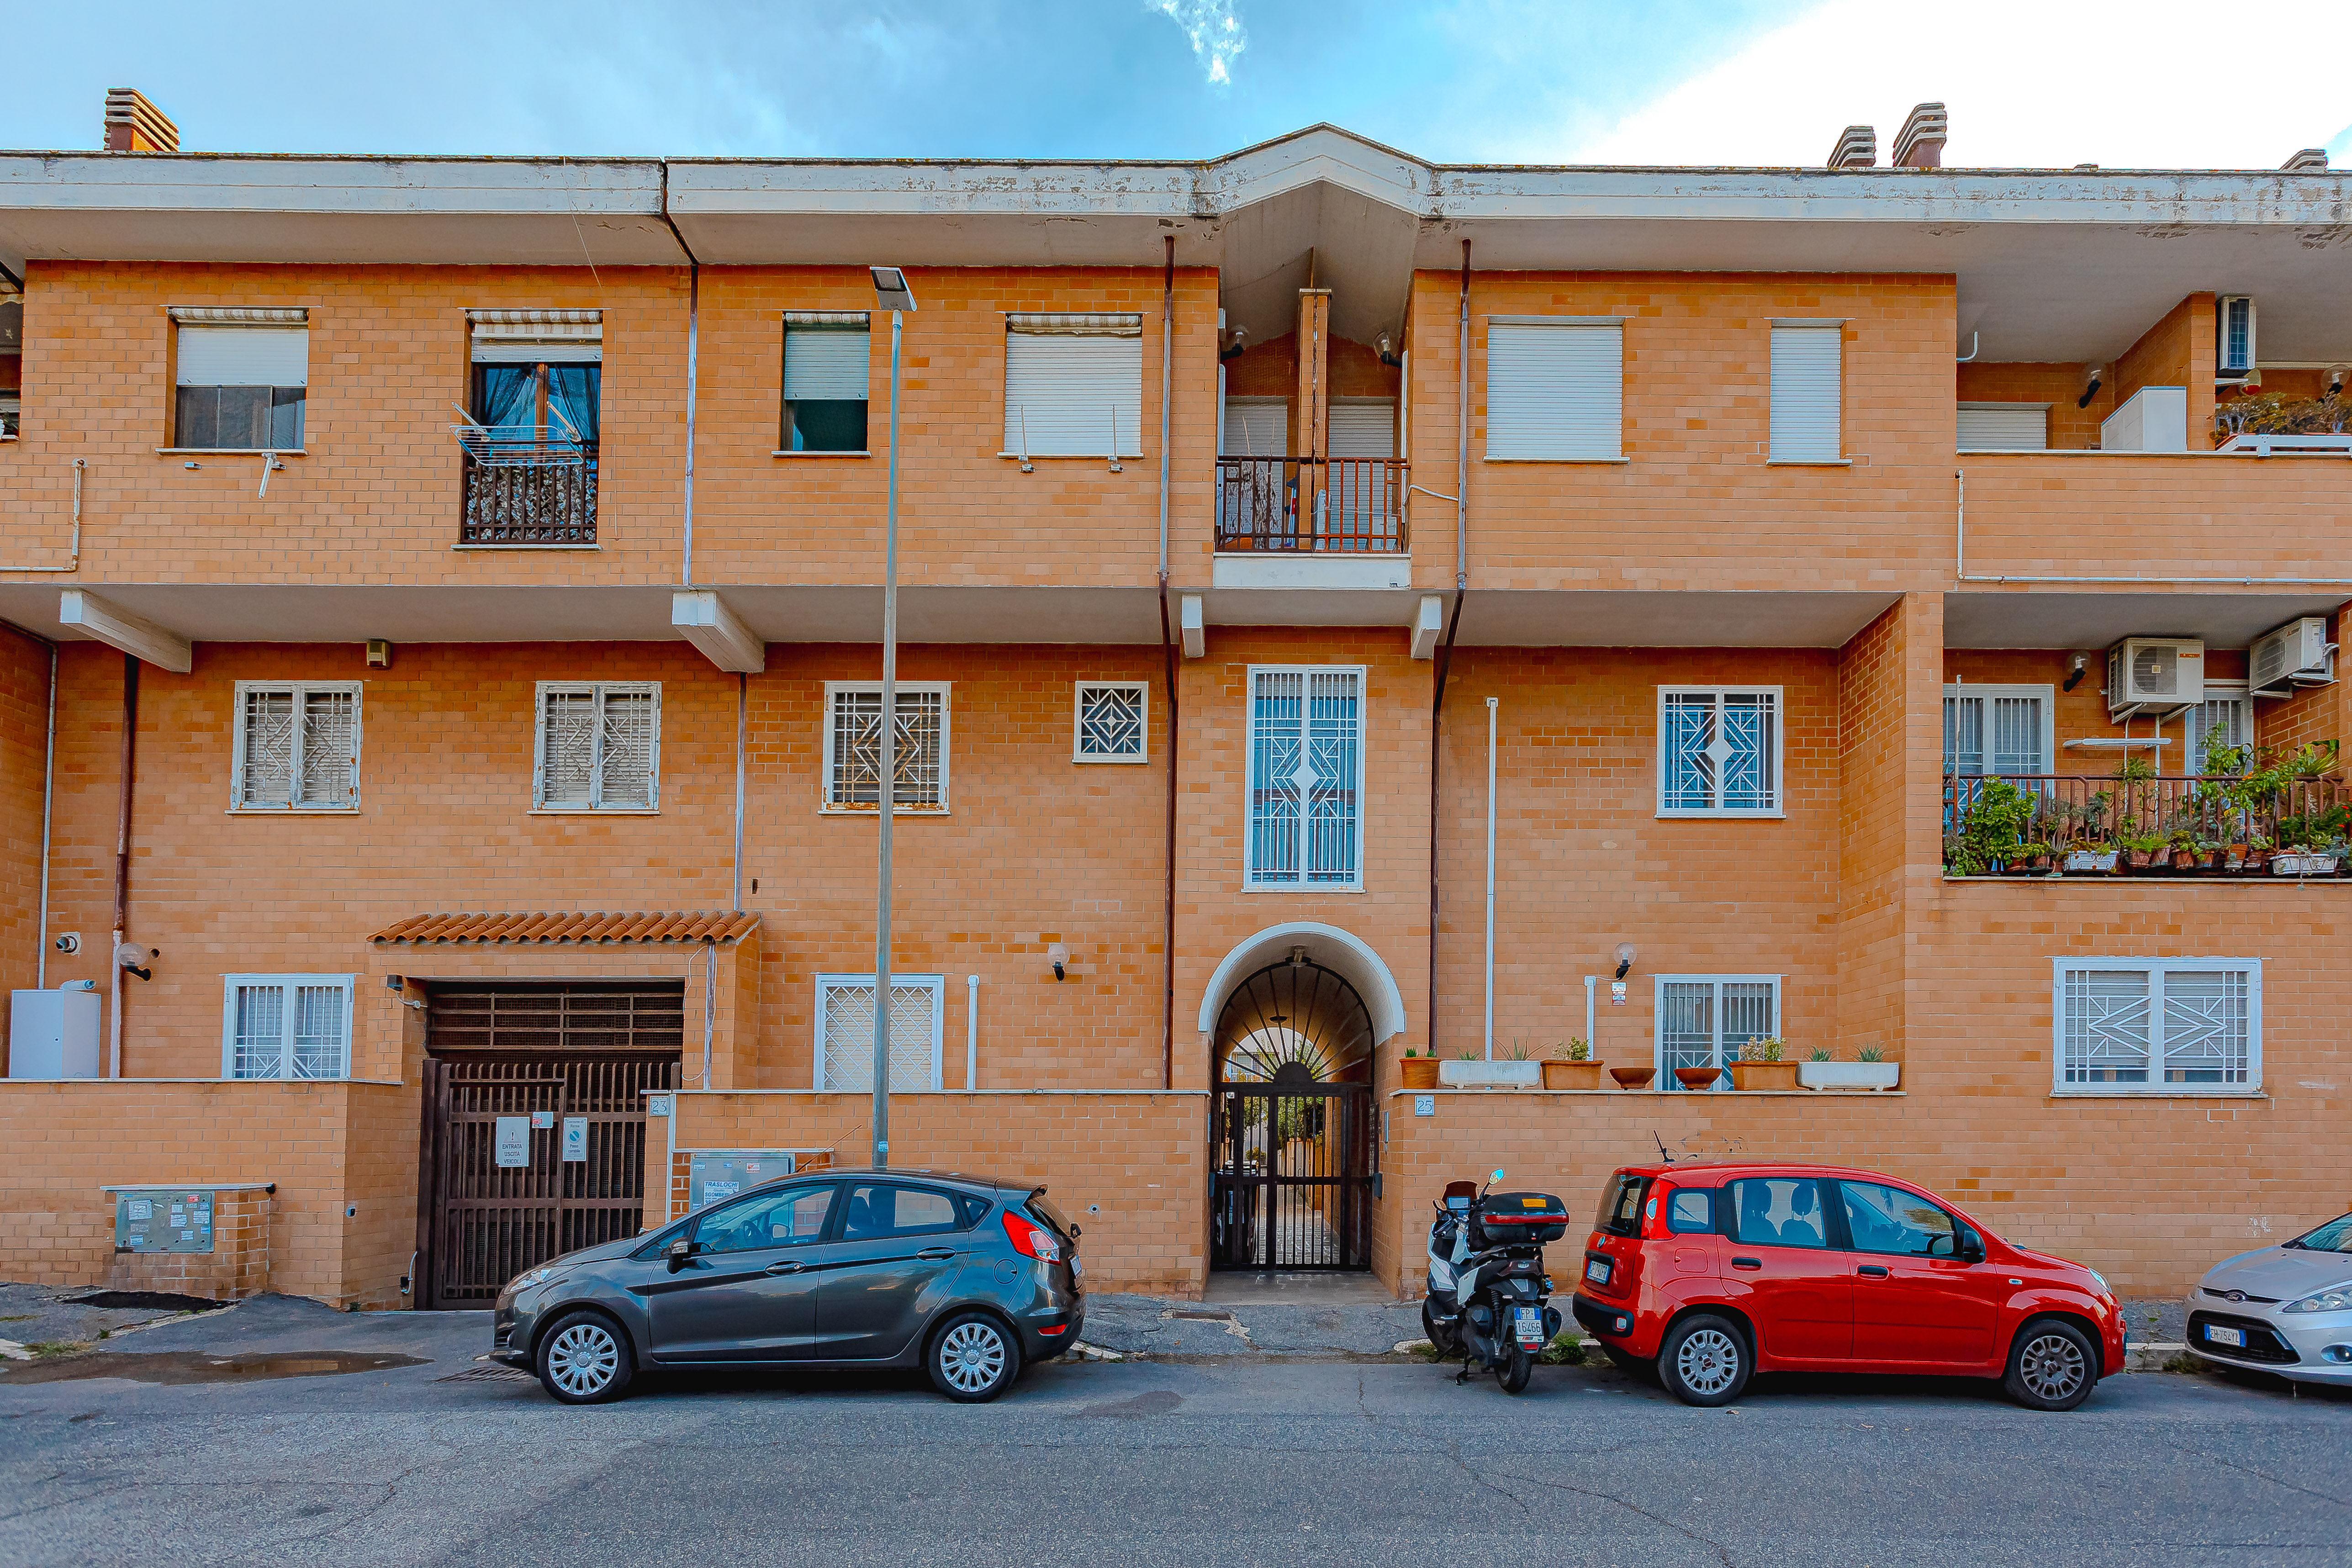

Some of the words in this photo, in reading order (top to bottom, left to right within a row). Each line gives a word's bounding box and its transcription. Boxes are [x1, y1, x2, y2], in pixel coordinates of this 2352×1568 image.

[652, 1101, 666, 1112] 23
[1418, 1100, 1432, 1112] 25
[1521, 1309, 1530, 1319] FP
[1517, 1322, 1541, 1332] 16466
